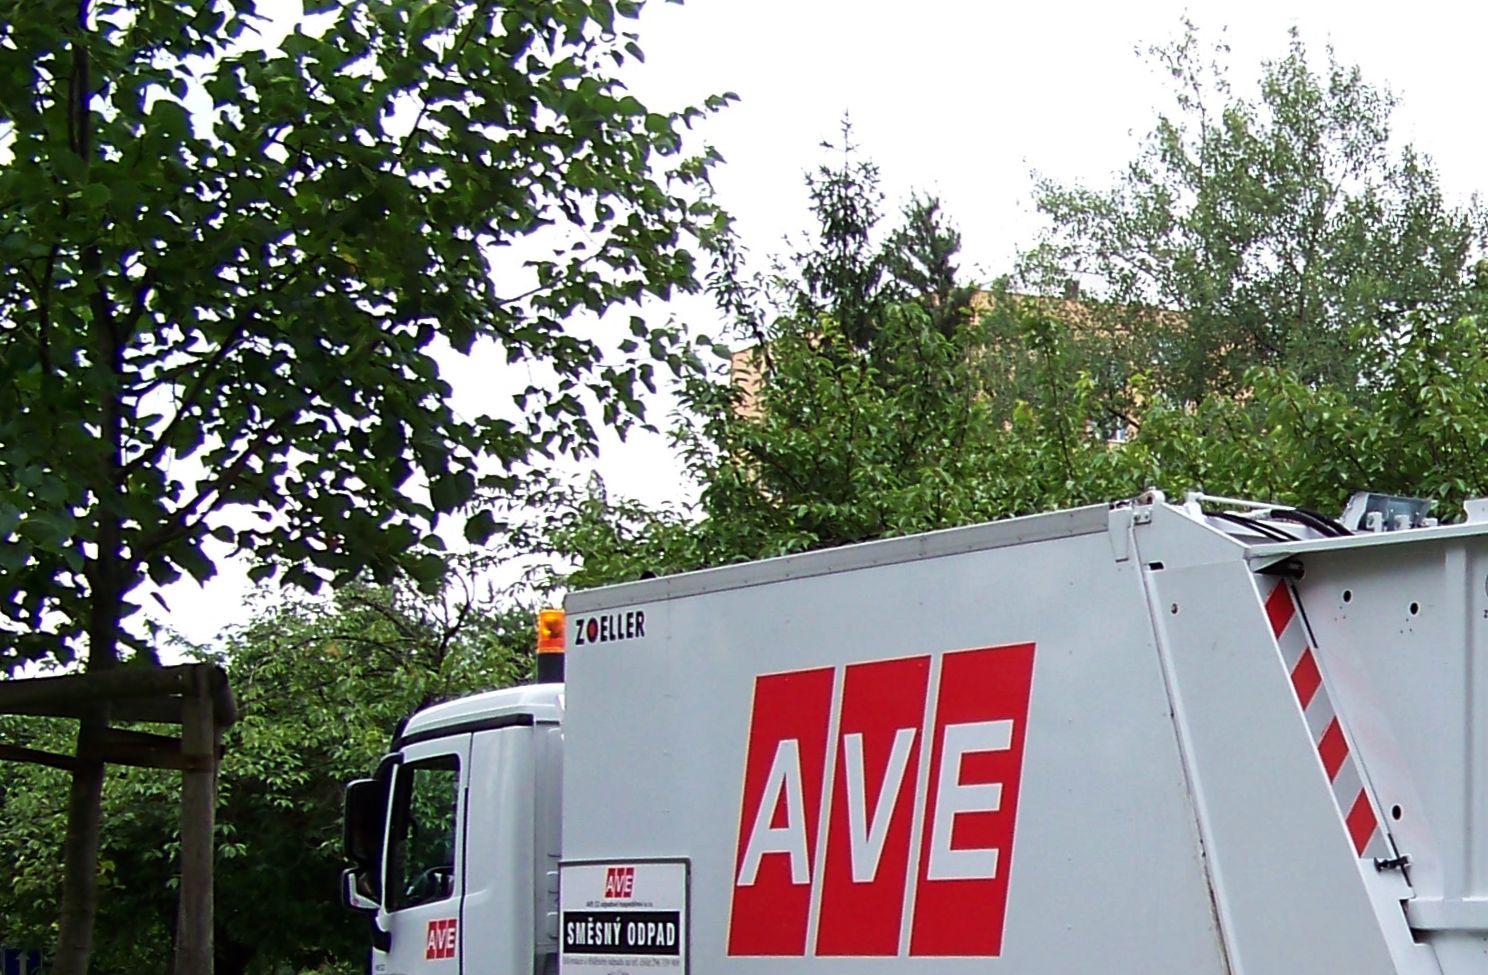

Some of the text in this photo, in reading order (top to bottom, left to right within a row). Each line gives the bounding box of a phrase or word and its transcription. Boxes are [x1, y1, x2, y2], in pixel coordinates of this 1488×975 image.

[575, 611, 645, 645] ZOELLER
[736, 718, 1015, 887] AVE
[606, 874, 632, 894] AVE
[427, 928, 456, 951] AVE
[566, 917, 676, 947] SMĚSNÝ ODPAD
